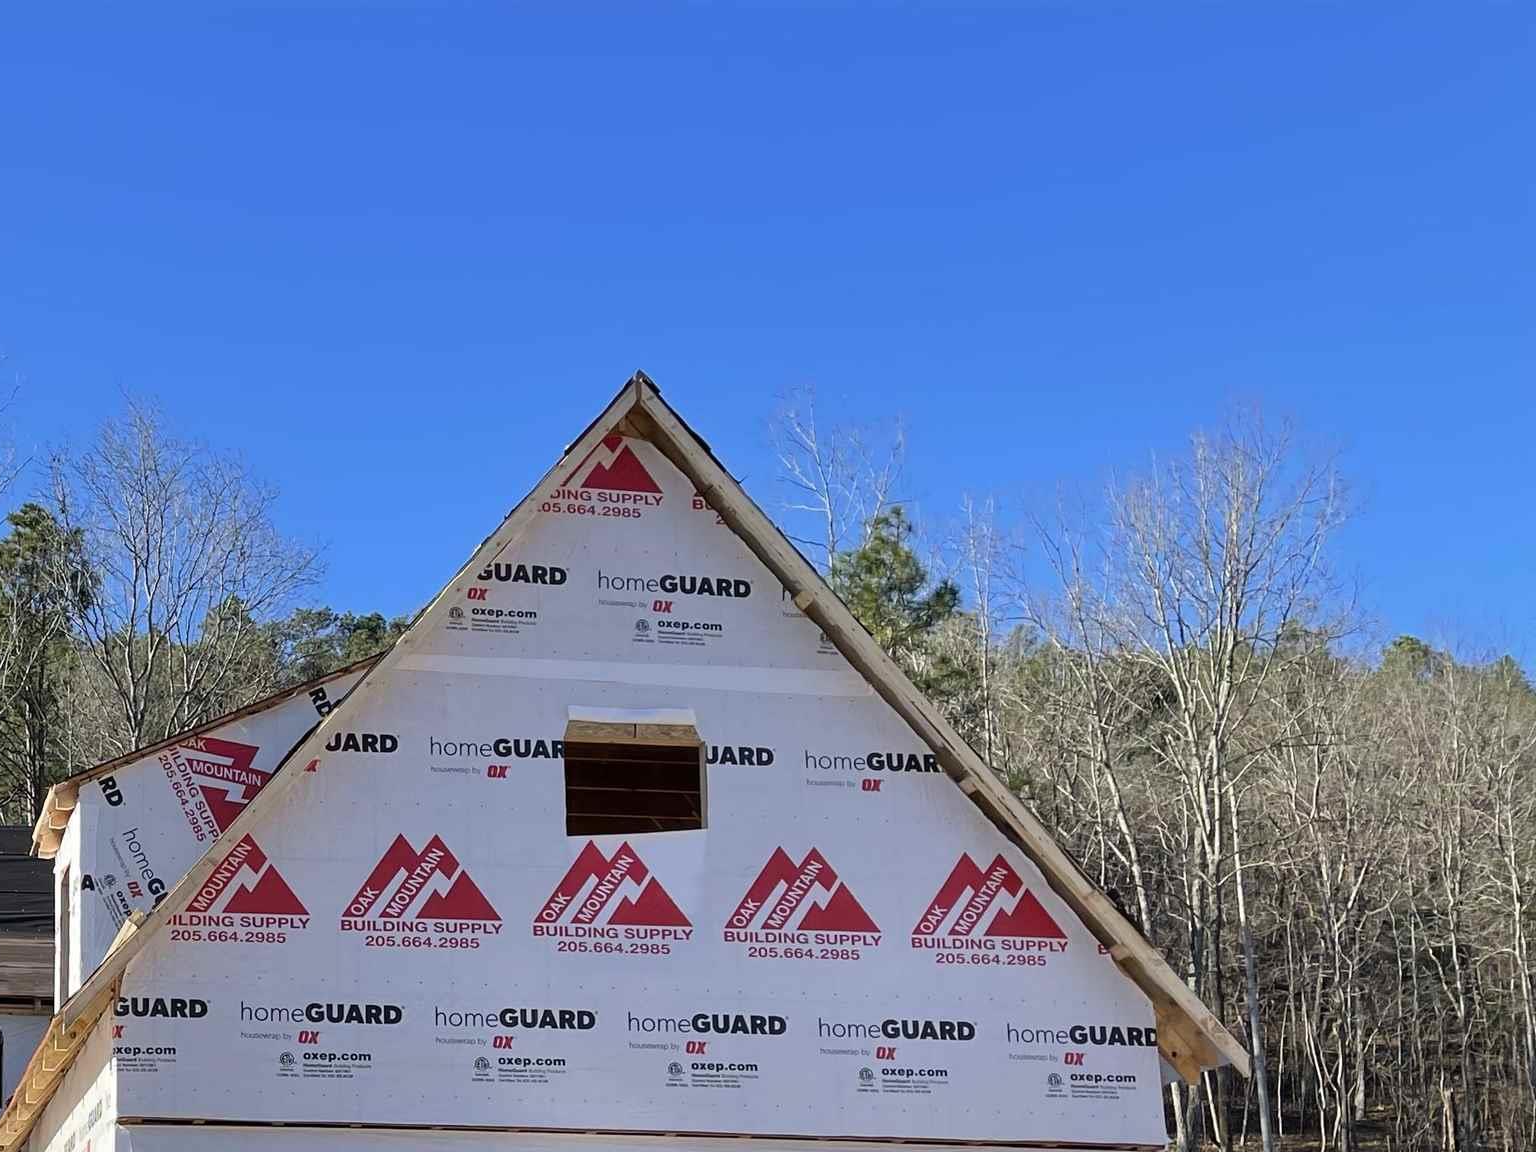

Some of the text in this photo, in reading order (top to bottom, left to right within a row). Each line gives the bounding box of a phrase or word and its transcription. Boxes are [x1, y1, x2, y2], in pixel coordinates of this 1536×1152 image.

[597, 491, 663, 507] SUPPLY
[537, 502, 641, 519] 05.664.2985
[597, 569, 752, 598] homeGUARD
[467, 587, 487, 601] OX
[471, 607, 537, 620] oxep.com
[653, 600, 673, 613] OX
[657, 619, 723, 632] oxep.com
[429, 736, 565, 760] homeGUAR
[804, 750, 942, 774] homeGUAR
[192, 760, 263, 786] MOUNTAIN
[487, 765, 510, 779] OX
[861, 778, 882, 792] OX
[158, 754, 207, 842] 205.664.2985
[193, 842, 253, 911] MOUNTAIN
[389, 847, 445, 918] MOUNTAIN
[580, 855, 634, 923] MOUNTAIN
[769, 860, 823, 928] MOUNTAIN
[351, 885, 379, 917] OAK
[542, 892, 571, 922] OAK
[955, 866, 1009, 935] MOUNTAIN
[733, 898, 761, 927] OAK
[920, 904, 948, 933] OAK
[240, 916, 310, 929] SUPPLY
[340, 919, 503, 936] BUILDING SUPPLY
[171, 930, 286, 944] 205.664.2985
[532, 925, 693, 941] BUILDING SUPPLY
[724, 930, 882, 947] BUILDING SUPPLY
[365, 936, 480, 949] 205.664.2985
[557, 941, 670, 955] 205.664.2985
[911, 936, 1068, 952] BUILDING SUPPLY
[748, 946, 860, 960] 205.664.2985
[935, 952, 1047, 966] 205.664.2985
[240, 1001, 402, 1025] homeGUARD
[434, 1006, 596, 1030] homeGUARD
[627, 1012, 787, 1035] homeGUARD
[818, 1018, 976, 1041] homeGUARD
[298, 1030, 319, 1044] OX
[492, 1036, 514, 1049] OX
[1007, 1024, 1158, 1047] homeGUARD
[685, 1041, 707, 1054] OX
[876, 1047, 897, 1060] OX
[303, 1051, 372, 1063] oxep.com
[498, 1056, 566, 1068] oxep.com
[1064, 1052, 1085, 1066] OX
[691, 1061, 758, 1073] oxep.com
[881, 1067, 948, 1079] oxep.com
[1070, 1073, 1136, 1084] oxep.com
